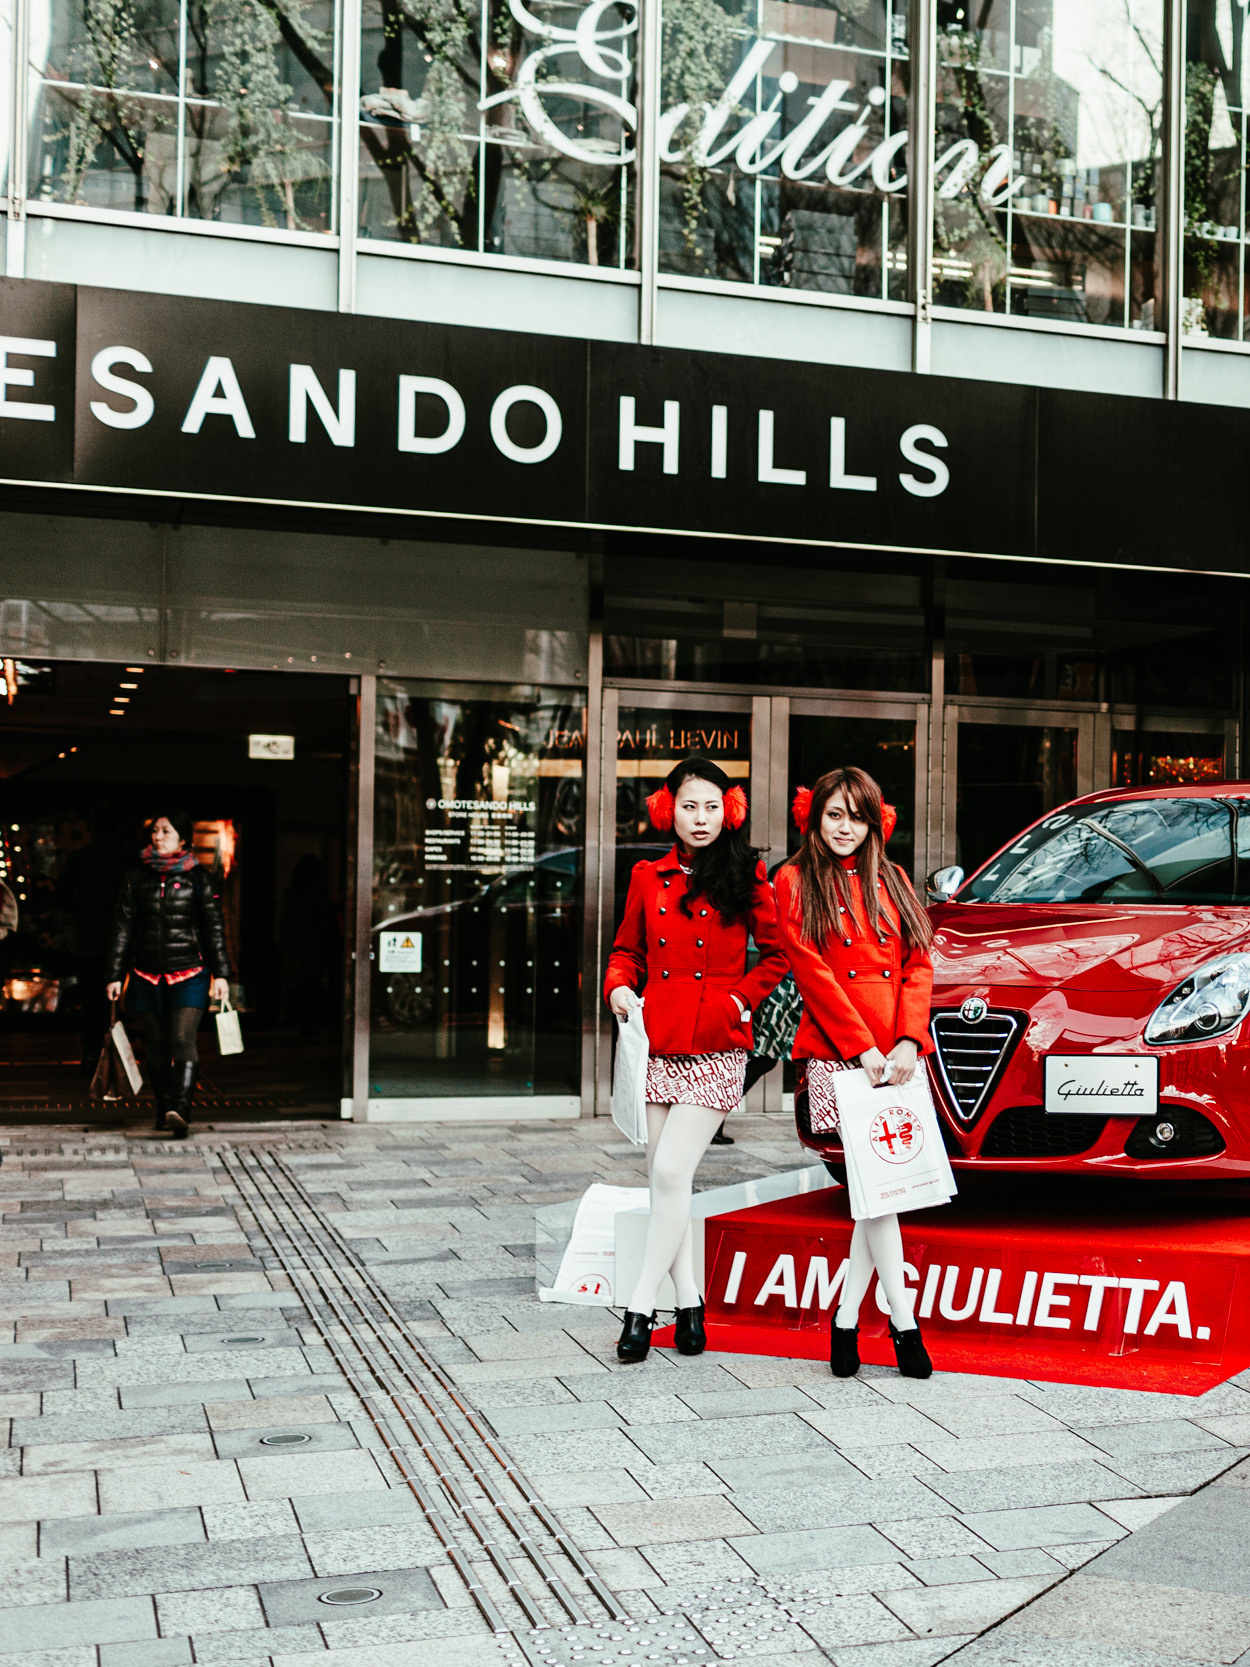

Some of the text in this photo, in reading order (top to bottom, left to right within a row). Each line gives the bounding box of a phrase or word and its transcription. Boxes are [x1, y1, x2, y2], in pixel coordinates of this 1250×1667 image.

[478, 0, 1027, 207] Edition
[0, 336, 950, 498] ESANDO HILLS
[438, 799, 536, 812] OMOTESANDO HILLS
[1057, 1079, 1144, 1101] Giulietta
[872, 1108, 922, 1142] ALFA ROMEO
[723, 1250, 1212, 1341] I AM GIULIETTA.
